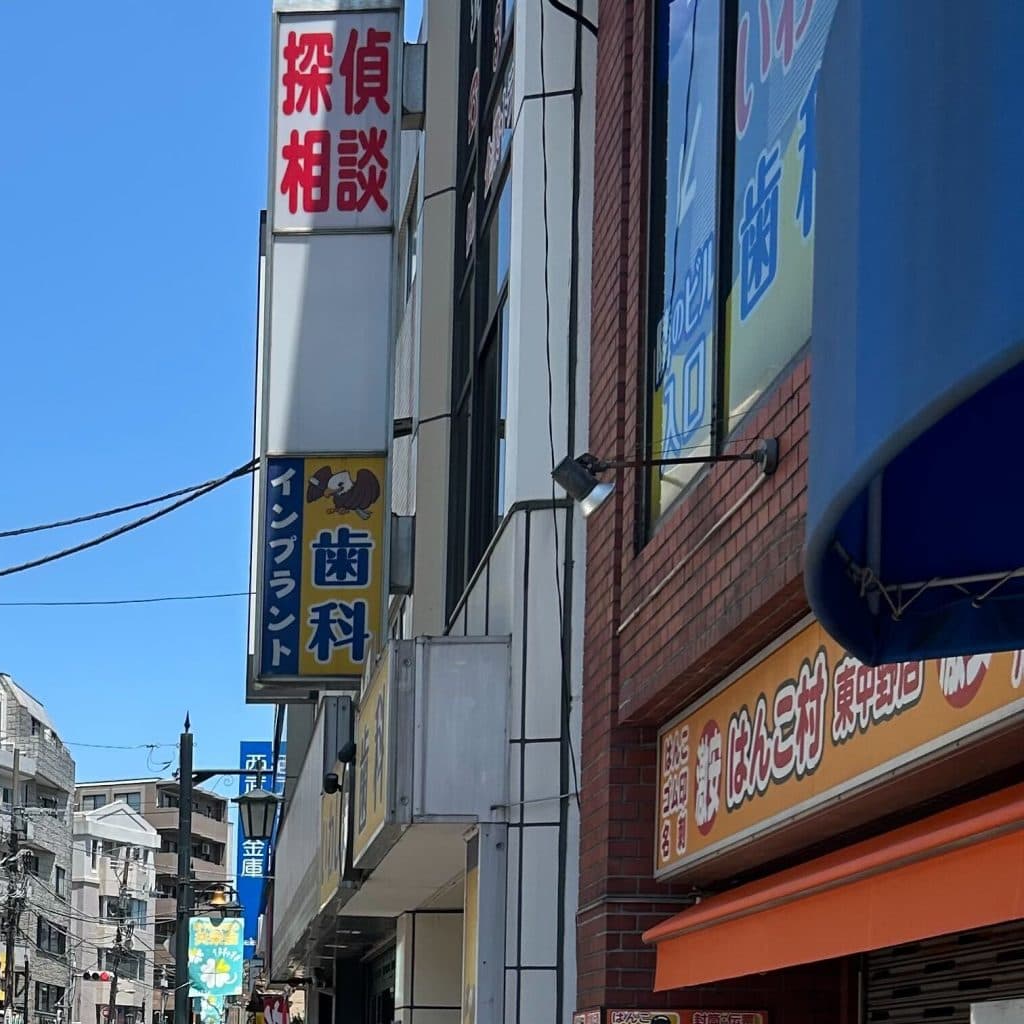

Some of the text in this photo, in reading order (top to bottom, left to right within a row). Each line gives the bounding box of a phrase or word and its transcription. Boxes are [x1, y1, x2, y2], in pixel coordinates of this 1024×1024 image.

[282, 28, 391, 115] 探偵
[281, 127, 388, 214] 相談
[660, 332, 708, 476] 入口
[268, 467, 298, 667] インプラント
[307, 526, 374, 664] 歯科
[663, 725, 689, 777] はんこ
[726, 651, 828, 810] はんこ村
[663, 767, 689, 818] ゴム印
[612, 1011, 651, 1024] はんこ
